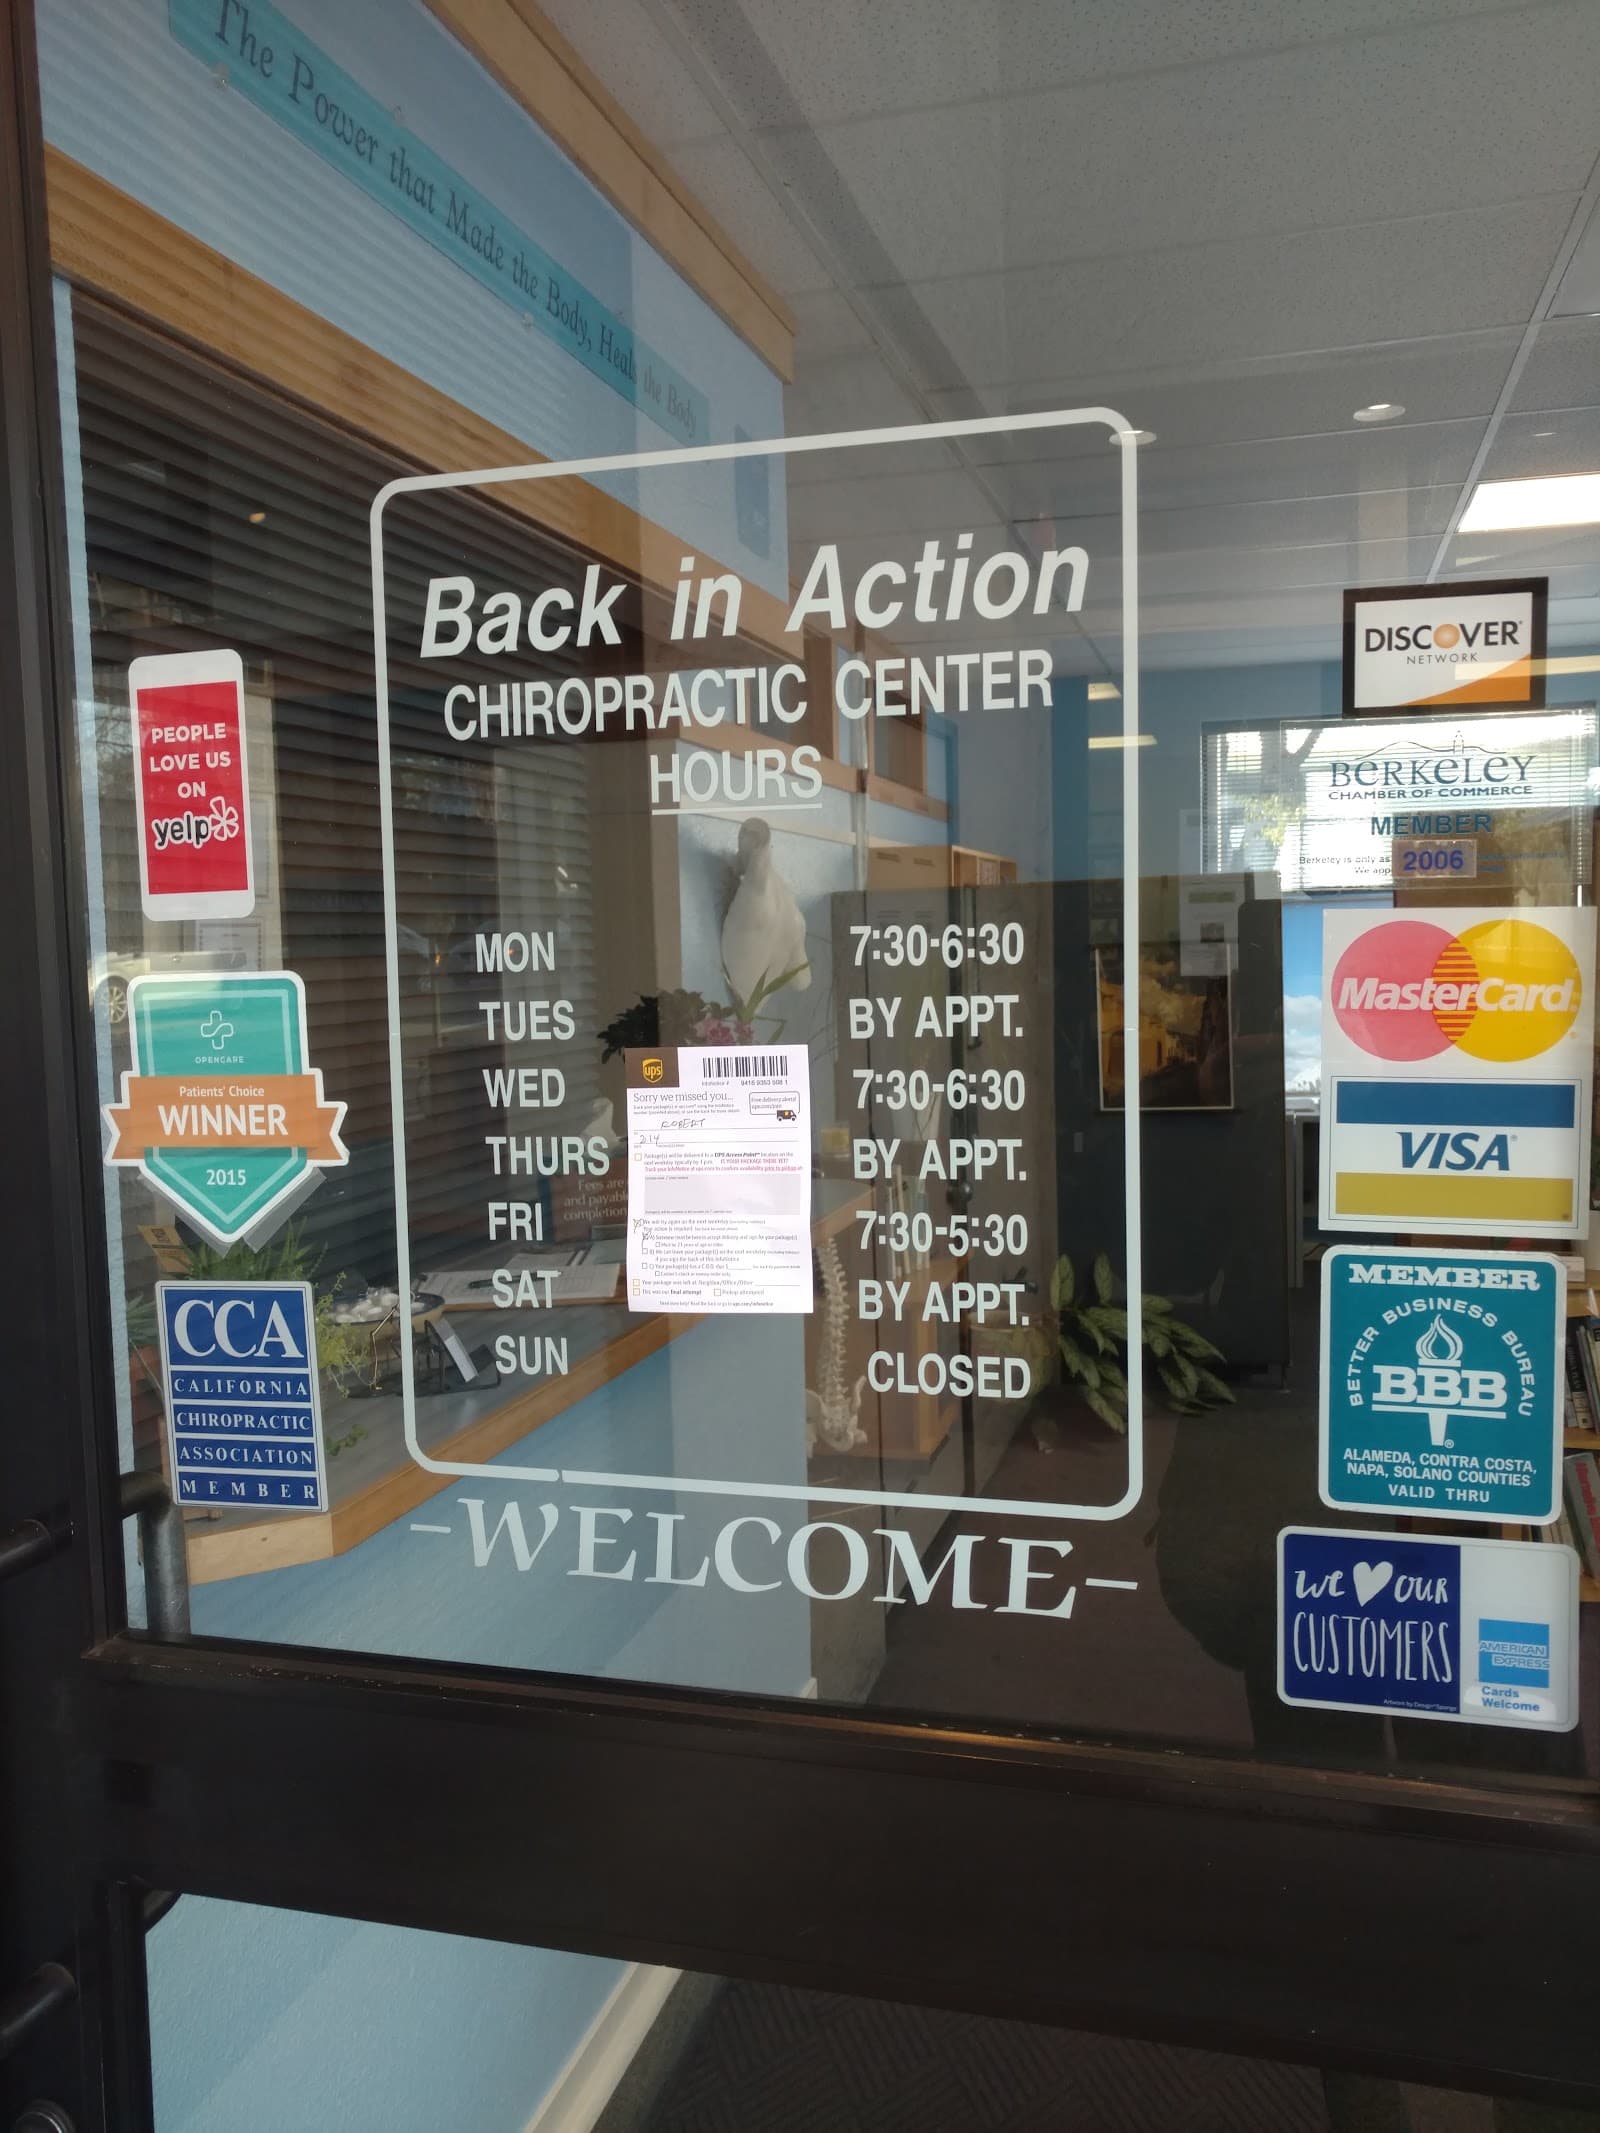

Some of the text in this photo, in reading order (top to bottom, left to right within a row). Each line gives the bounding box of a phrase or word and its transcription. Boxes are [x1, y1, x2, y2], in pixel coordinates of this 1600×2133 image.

[214, 0, 273, 79] The
[288, 55, 378, 164] Power
[391, 148, 434, 214] that
[446, 190, 504, 270] Made
[513, 253, 538, 299] the
[546, 276, 592, 352] Body,
[600, 324, 638, 384] Heals
[420, 533, 1089, 658] Back in Action
[1365, 621, 1520, 652] DISCOVER
[1407, 652, 1478, 665] NETWORK
[444, 649, 1054, 741] CHIROPRACTIC CENTER
[152, 722, 226, 744] PEOPLE
[150, 751, 231, 772] LOVE US
[650, 745, 822, 804] HOURS
[177, 781, 206, 798] ON
[1328, 785, 1533, 800] CHAMBER OF COMMERCE
[154, 812, 209, 847] yelp
[1371, 814, 1491, 836] MEMBER
[1299, 856, 1341, 865] Berkeley
[1355, 855, 1376, 865] only
[1403, 850, 1464, 871] 2006
[475, 922, 1024, 973] MON 7:30-6:30
[479, 994, 1023, 1041] TUES BY APPT.
[195, 1056, 244, 1064] OPENCARE
[645, 1066, 661, 1079] ups
[179, 1085, 265, 1097] Patients' Choice
[482, 1068, 1025, 1111] WED 7:30-6:30
[634, 1093, 658, 1104] Sorry
[675, 1092, 707, 1101] missed
[158, 1104, 288, 1136] WINNER
[485, 1136, 1027, 1181] THURS BY APPT.
[1396, 1132, 1510, 1171] VISA
[206, 1169, 246, 1186] 2015
[578, 1179, 604, 1190] Fees
[564, 1193, 585, 1207] and
[488, 1202, 1028, 1257] FRI 7:30-5:30
[1348, 1264, 1540, 1290] MEMBER
[492, 1268, 1029, 1325] SAT BY APPT.
[174, 1299, 304, 1358] CCA
[495, 1335, 1031, 1398] SUN CLOSED
[1346, 1326, 1379, 1407] BETTER
[1382, 1298, 1498, 1327] BUSINESS
[1501, 1331, 1536, 1416] BUREAU
[174, 1379, 308, 1396] CALIFORNIA
[1372, 1365, 1508, 1408] BBB
[176, 1412, 313, 1430] CHIROPRACTIC
[180, 1446, 313, 1464] ASSOCIATION
[1343, 1448, 1537, 1474] ALAMEDA, CONTRA COSTA,
[1347, 1463, 1531, 1487] NAPA, SOLANO COUNTIES
[182, 1480, 315, 1499] MEMBER
[1388, 1484, 1490, 1503] VALID THRU
[1294, 1612, 1452, 1683] CUSTOMERS
[1480, 1642, 1546, 1656] AMERICAN
[1493, 1656, 1550, 1670] EXPRESS
[1482, 1686, 1519, 1698] Cards
[1481, 1698, 1540, 1712] Welcome
